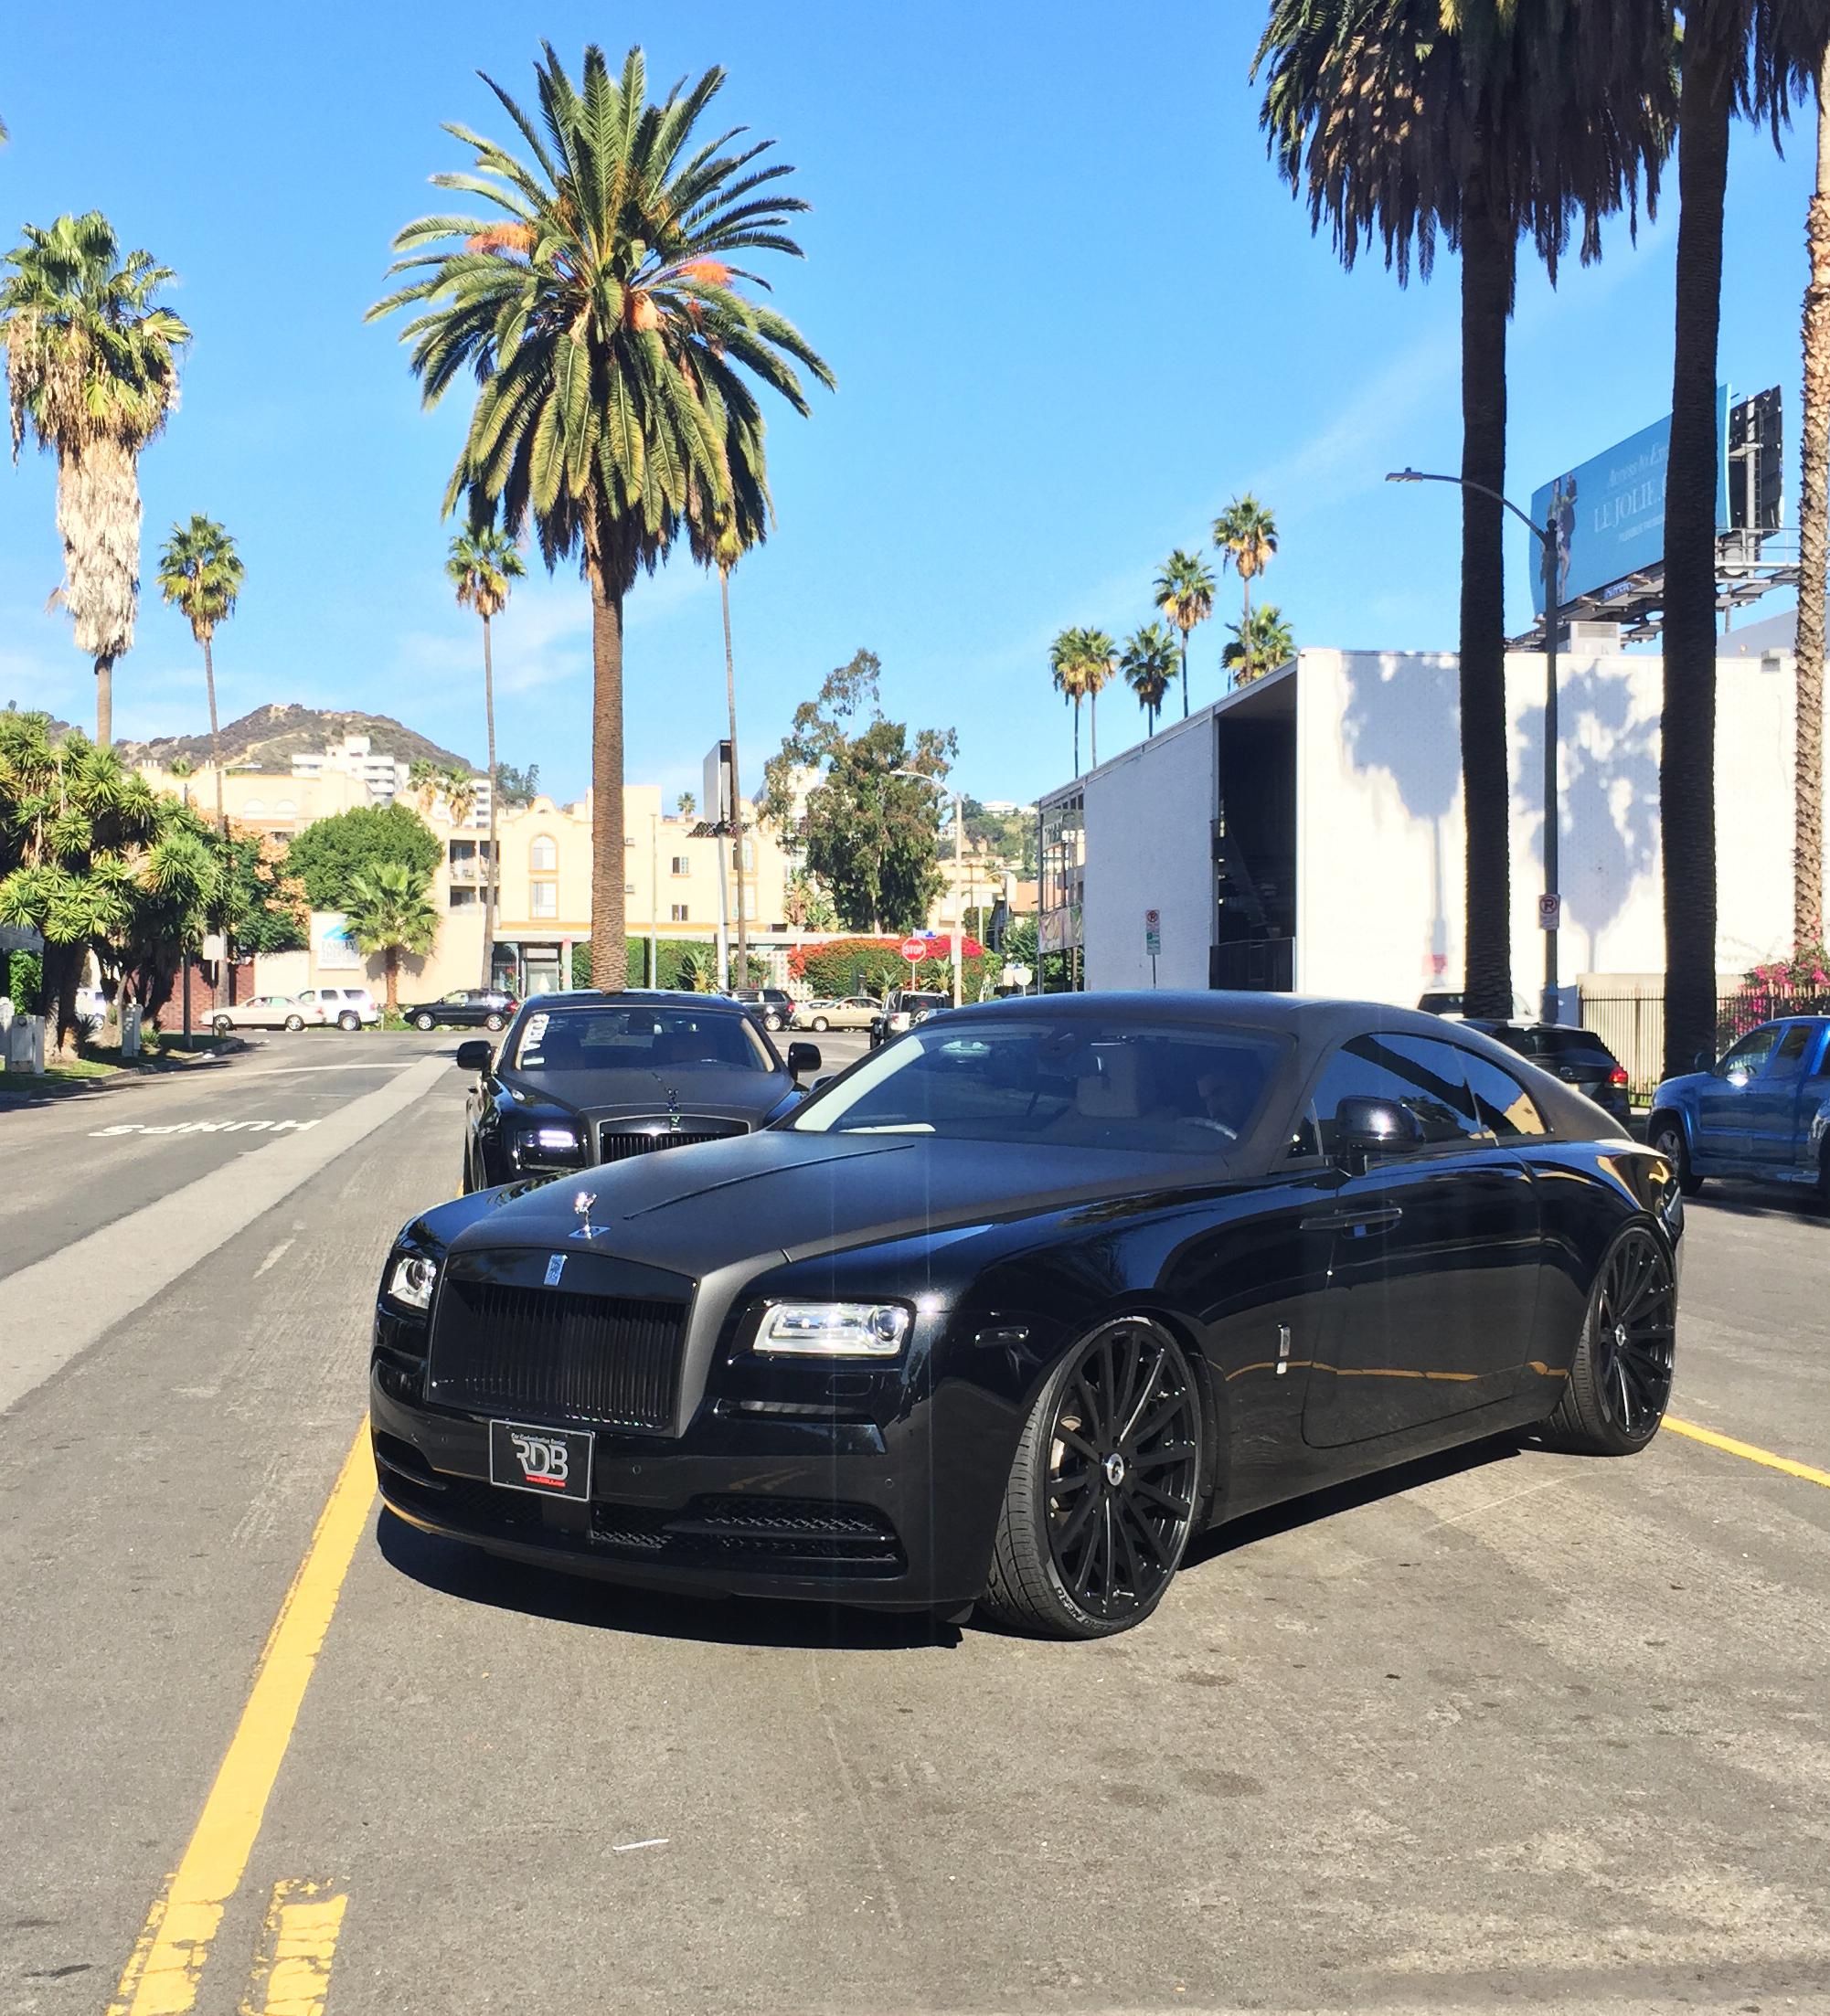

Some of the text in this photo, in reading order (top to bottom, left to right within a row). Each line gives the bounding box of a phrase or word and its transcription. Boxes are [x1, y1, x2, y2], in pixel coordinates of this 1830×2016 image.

[903, 945, 924, 955] STOP
[88, 1120, 322, 1137] HUMPS
[511, 1438, 569, 1480] RDB
